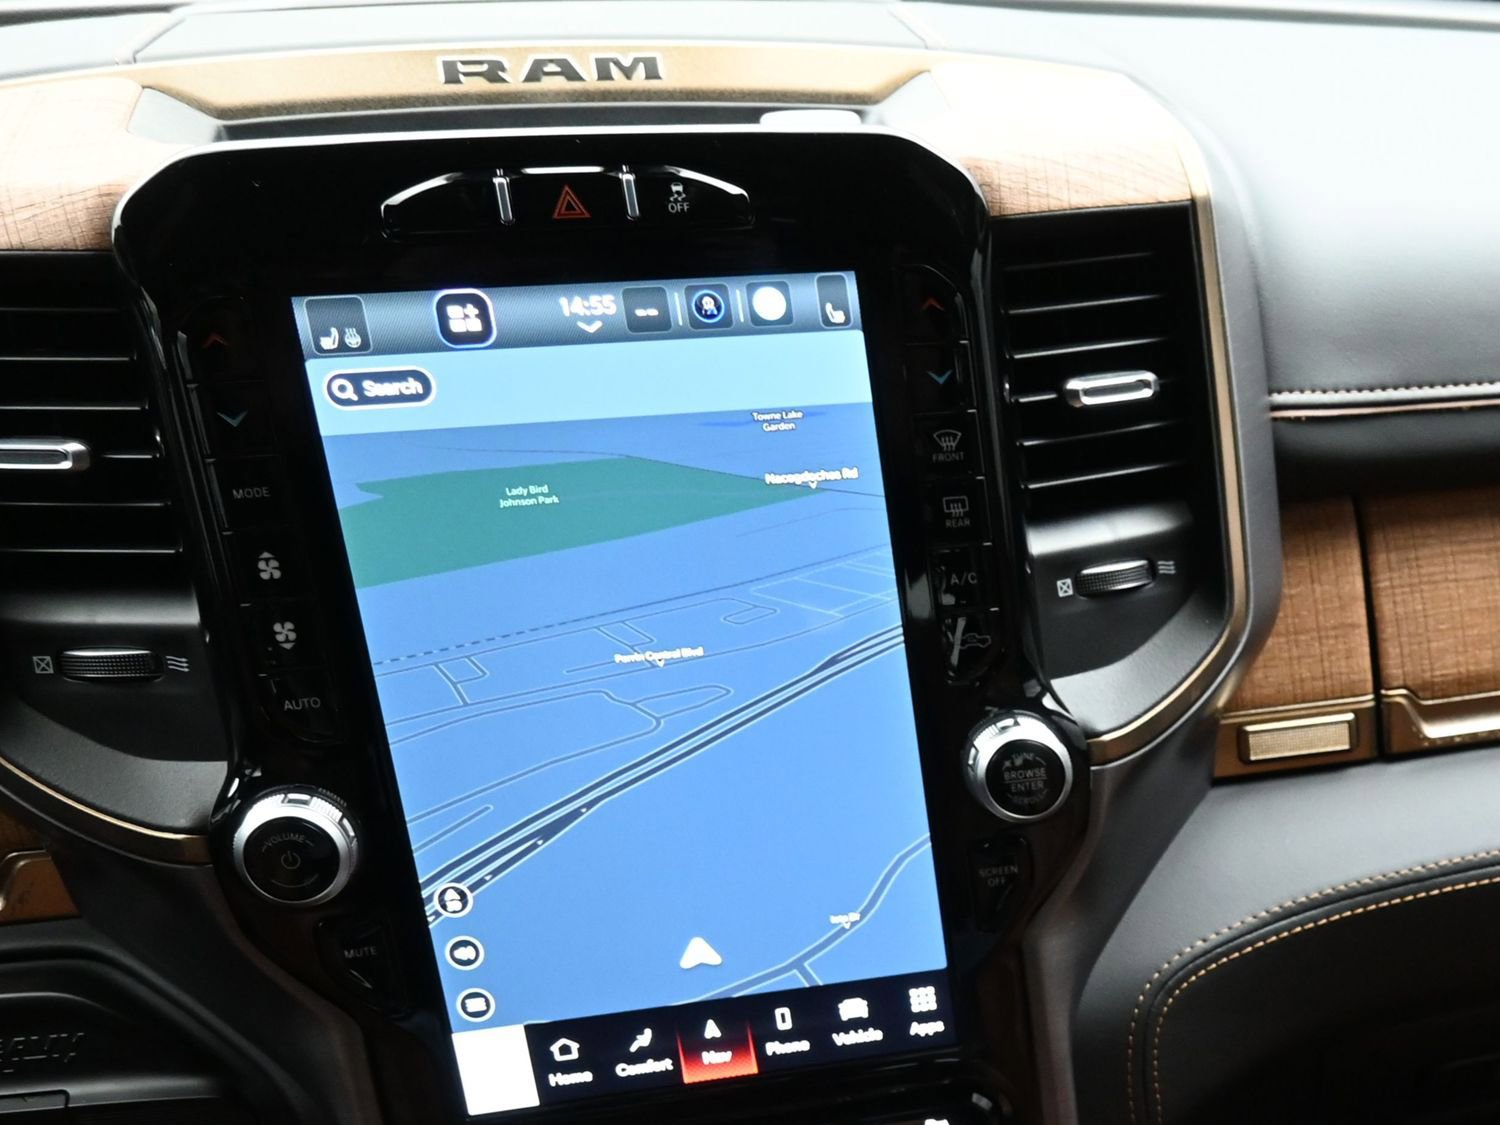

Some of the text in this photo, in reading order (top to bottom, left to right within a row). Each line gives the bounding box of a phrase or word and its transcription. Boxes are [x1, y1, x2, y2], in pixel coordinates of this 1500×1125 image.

[441, 55, 663, 85] RAM
[668, 201, 690, 214] OFF
[558, 294, 617, 317] 14:55
[361, 377, 424, 397] Search
[752, 410, 804, 421] Towne Lake
[762, 422, 796, 432] Garden
[932, 450, 965, 464] FRONT
[231, 485, 273, 500] MODE
[505, 484, 549, 497] Lady Bird
[499, 495, 560, 509] Johnson Park
[944, 516, 971, 529] REAR
[949, 570, 978, 586] A/C
[283, 696, 321, 712] AUTO
[1003, 767, 1048, 781] BROWSE
[1010, 780, 1044, 793] ENTER
[263, 831, 306, 847] VOLUME
[343, 946, 378, 959] MUTE
[831, 1027, 884, 1047] Vehicle
[909, 1020, 945, 1038] Apps
[764, 1038, 811, 1056] Phone
[701, 1049, 733, 1066] Nav
[614, 1056, 674, 1078] Comfort
[547, 1068, 593, 1087] Home
